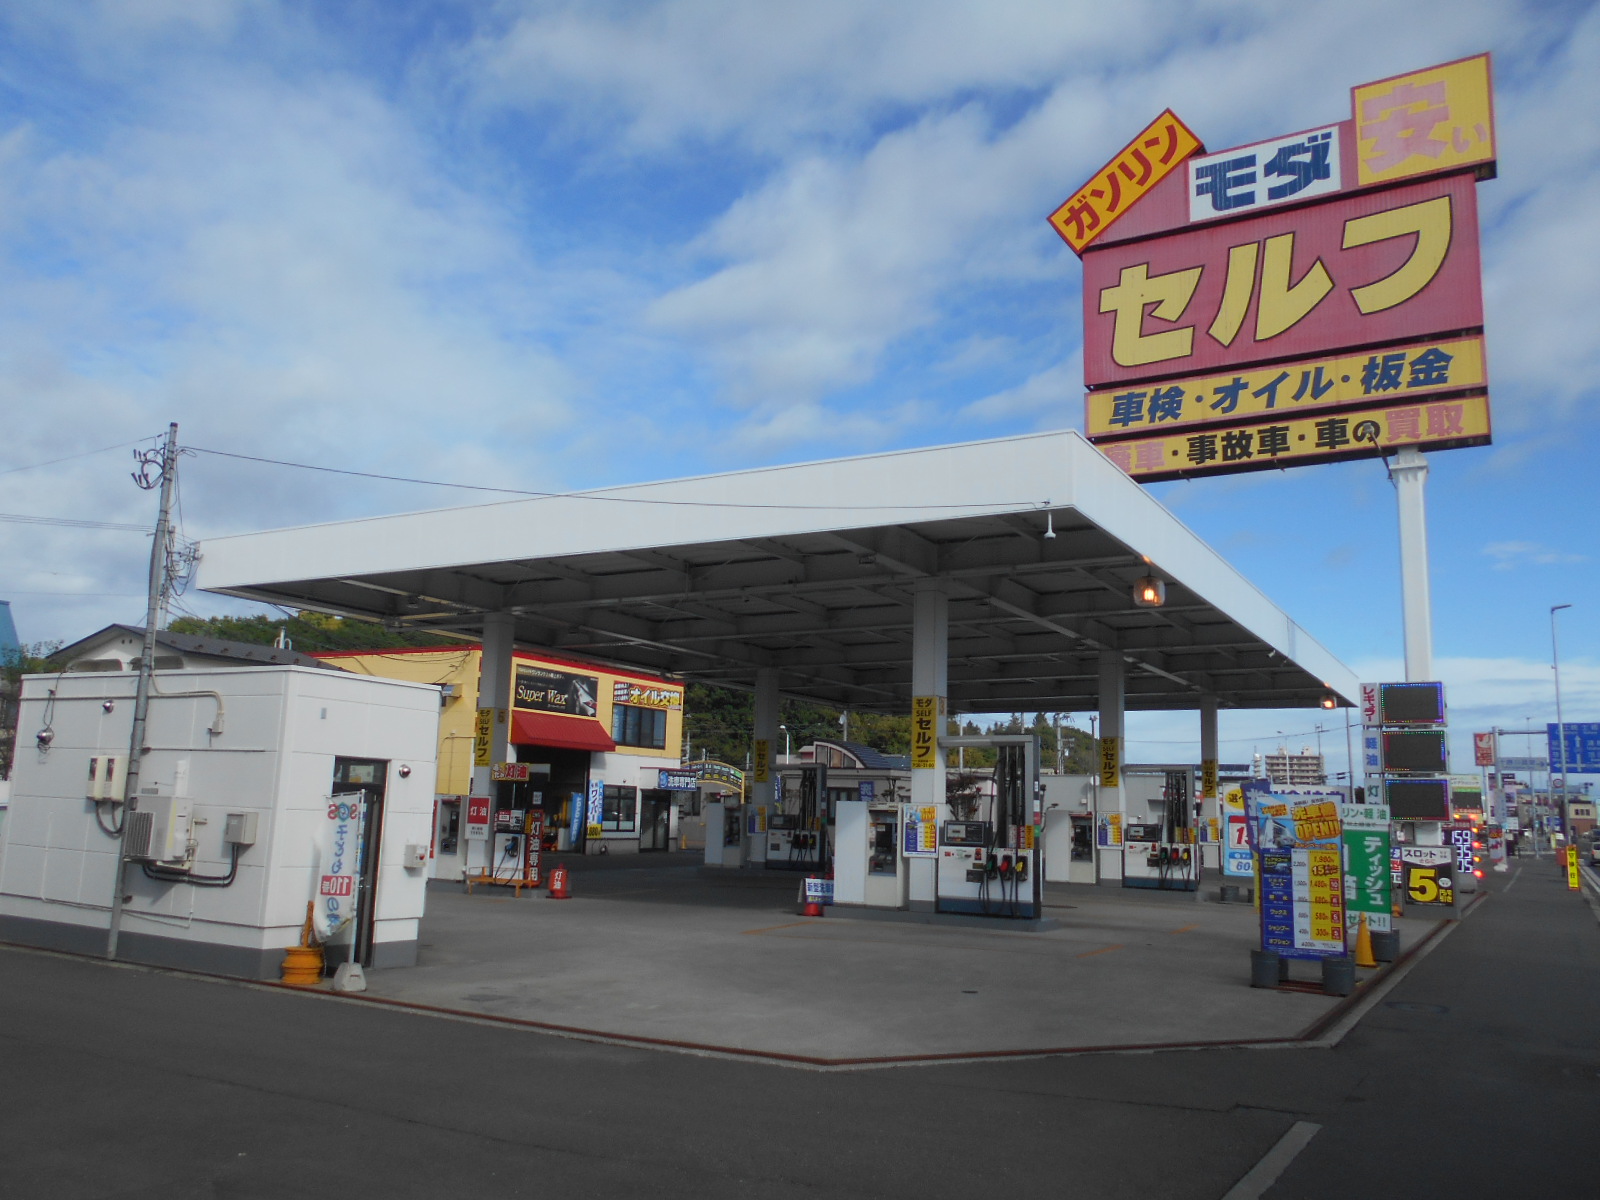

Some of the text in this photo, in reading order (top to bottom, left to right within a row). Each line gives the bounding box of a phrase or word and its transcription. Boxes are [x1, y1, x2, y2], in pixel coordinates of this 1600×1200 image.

[1360, 80, 1487, 174] 安い
[1064, 124, 1179, 240] ガソリン
[1195, 131, 1332, 211] モダ
[1098, 194, 1452, 367] セルフ
[1109, 347, 1454, 427] 車検・オイル・板金
[517, 685, 569, 705] Super Wax
[916, 698, 932, 708] モダ
[477, 726, 490, 758] セルフ
[916, 718, 931, 758] セルフ
[1102, 752, 1116, 780] セルフ
[470, 806, 487, 816] 灯油
[590, 789, 599, 822] ワイパー
[529, 821, 541, 881] 灯油専用
[1403, 849, 1436, 858] スロット
[1363, 836, 1384, 905] ティッシュ
[1408, 868, 1438, 902] 5
